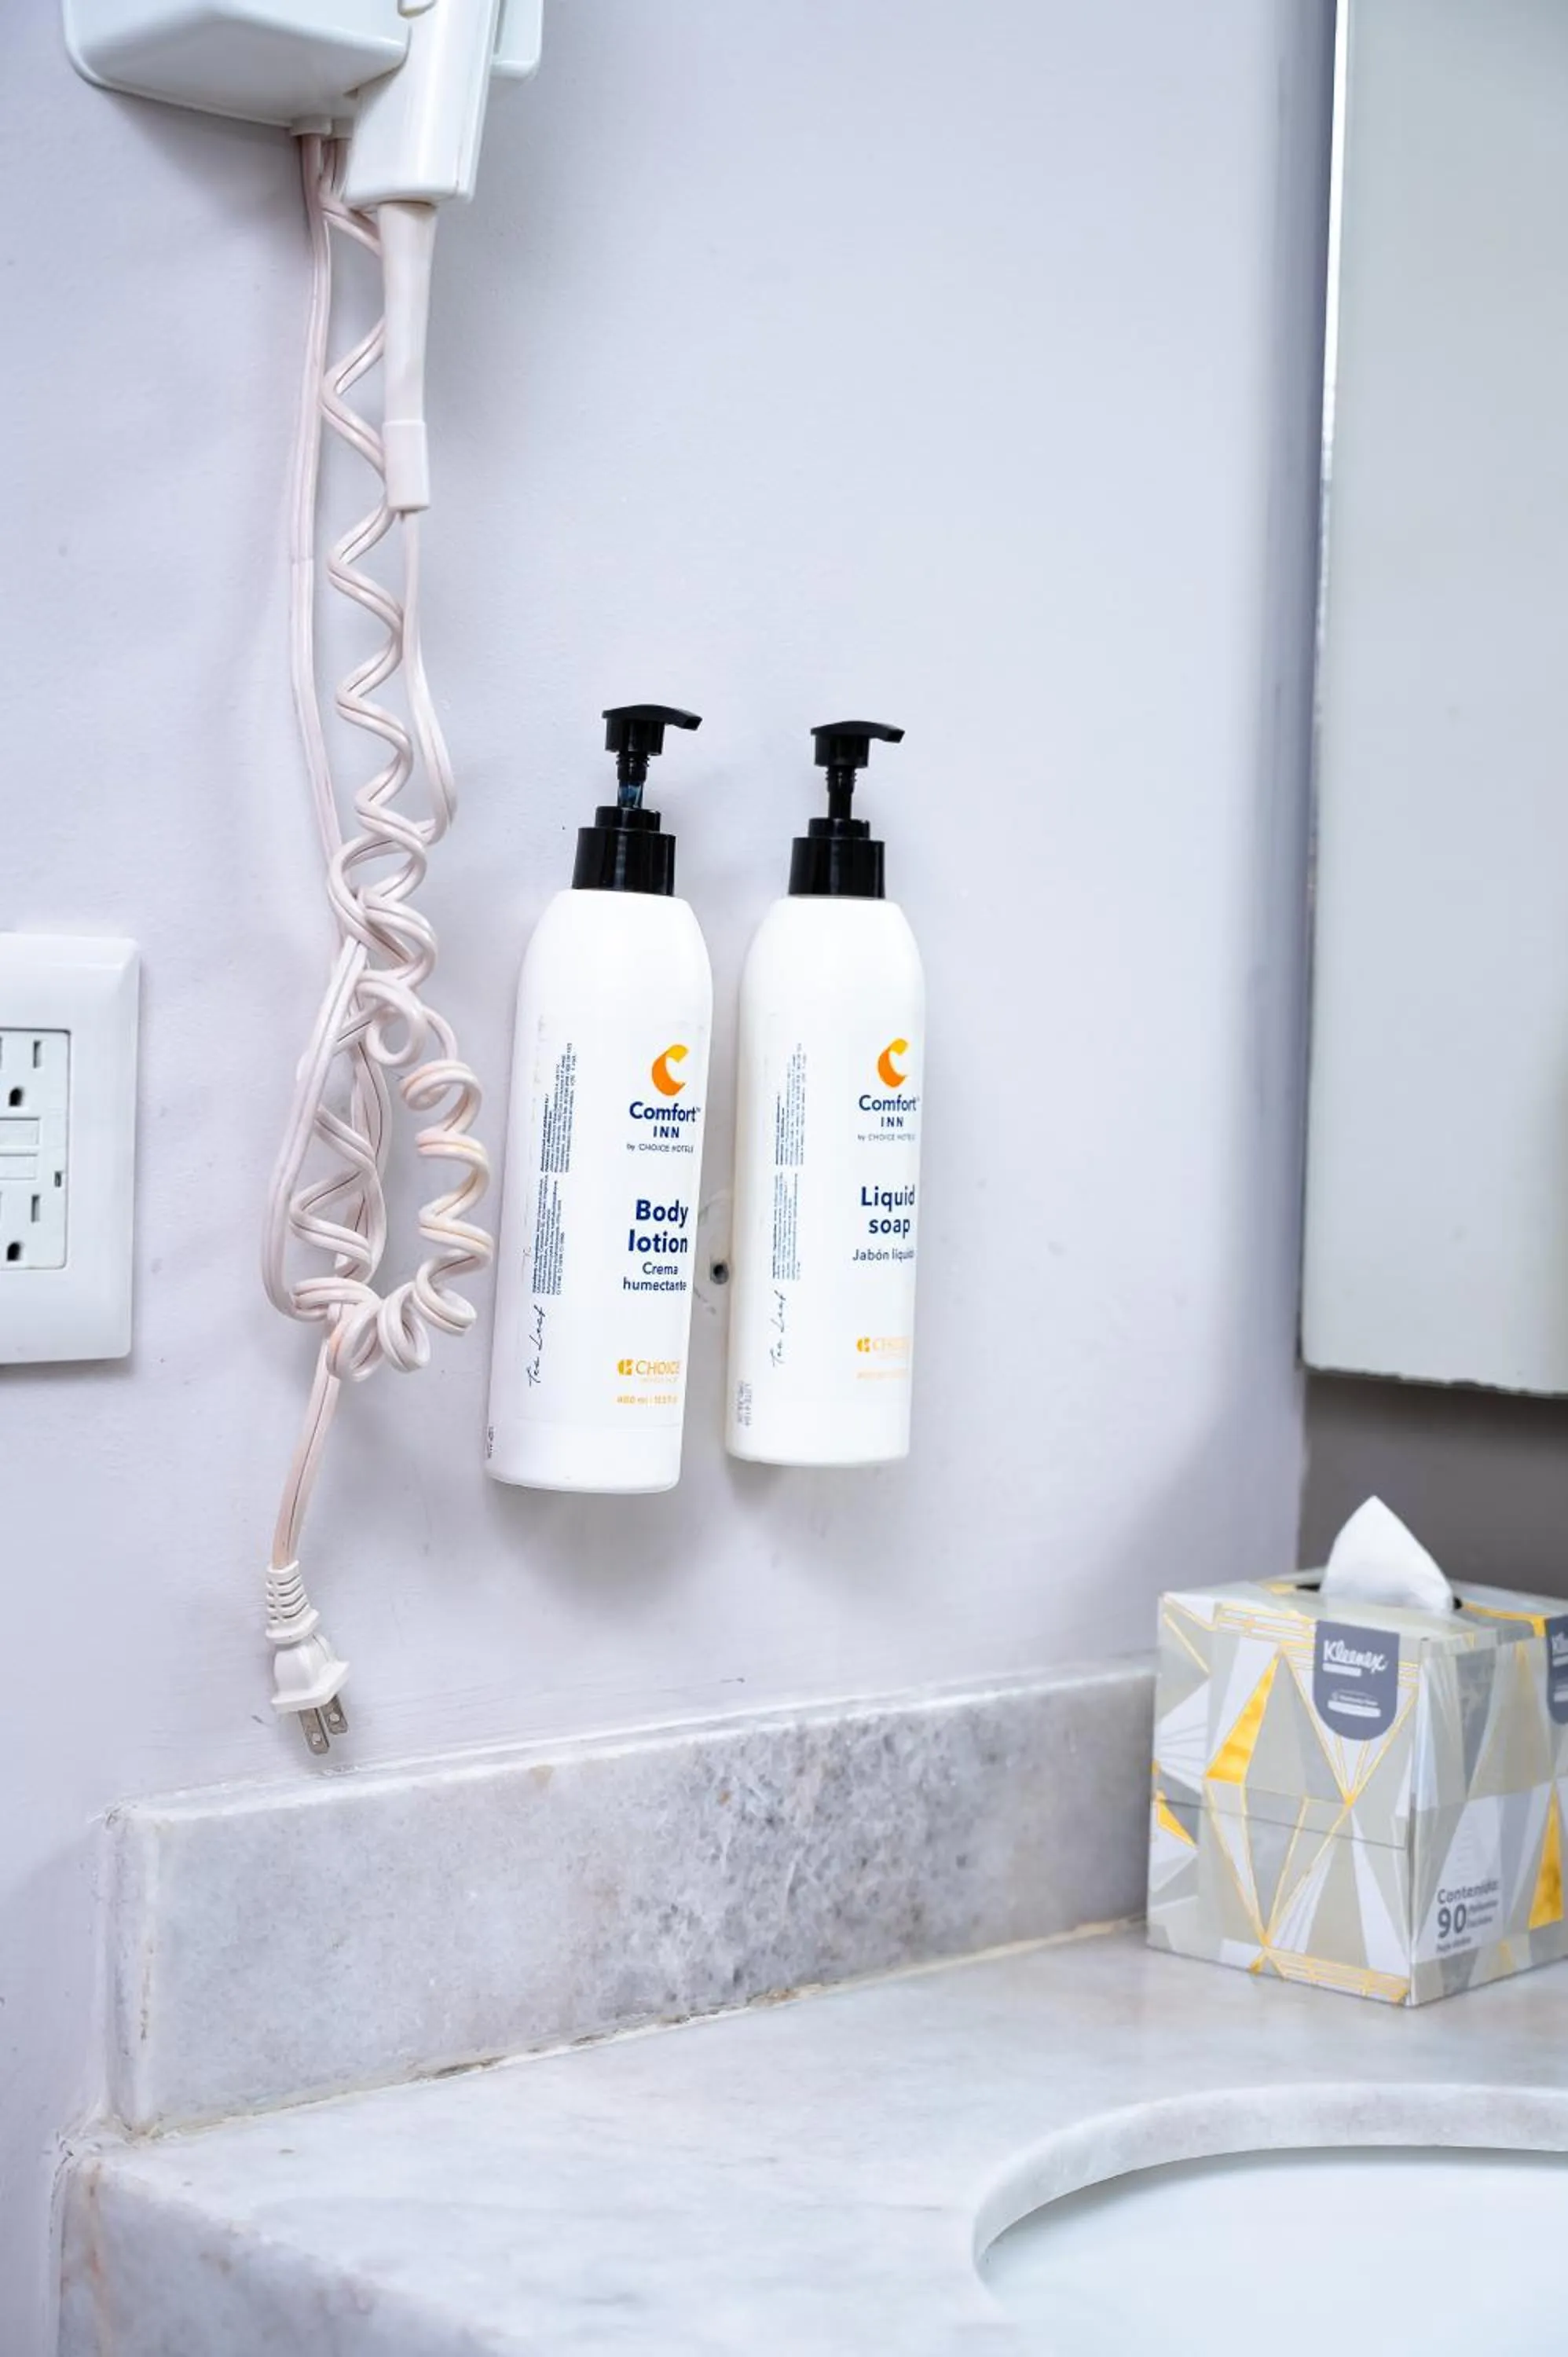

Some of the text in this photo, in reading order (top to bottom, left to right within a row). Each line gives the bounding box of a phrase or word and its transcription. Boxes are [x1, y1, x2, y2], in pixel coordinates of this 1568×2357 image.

[629, 1101, 697, 1123] Comfort
[859, 1094, 917, 1111] Comfort
[881, 1116, 903, 1127] INN
[654, 1126, 680, 1138] INN
[861, 1185, 915, 1212] Liquid
[636, 1199, 689, 1228] Body
[869, 1219, 910, 1238] soap
[628, 1229, 688, 1253] lotion
[852, 1248, 890, 1261] Jabón
[643, 1261, 678, 1274] Crema
[623, 1277, 687, 1291] humectante
[1323, 1640, 1388, 1674] Kleenex
[1438, 1904, 1467, 1938] 90
